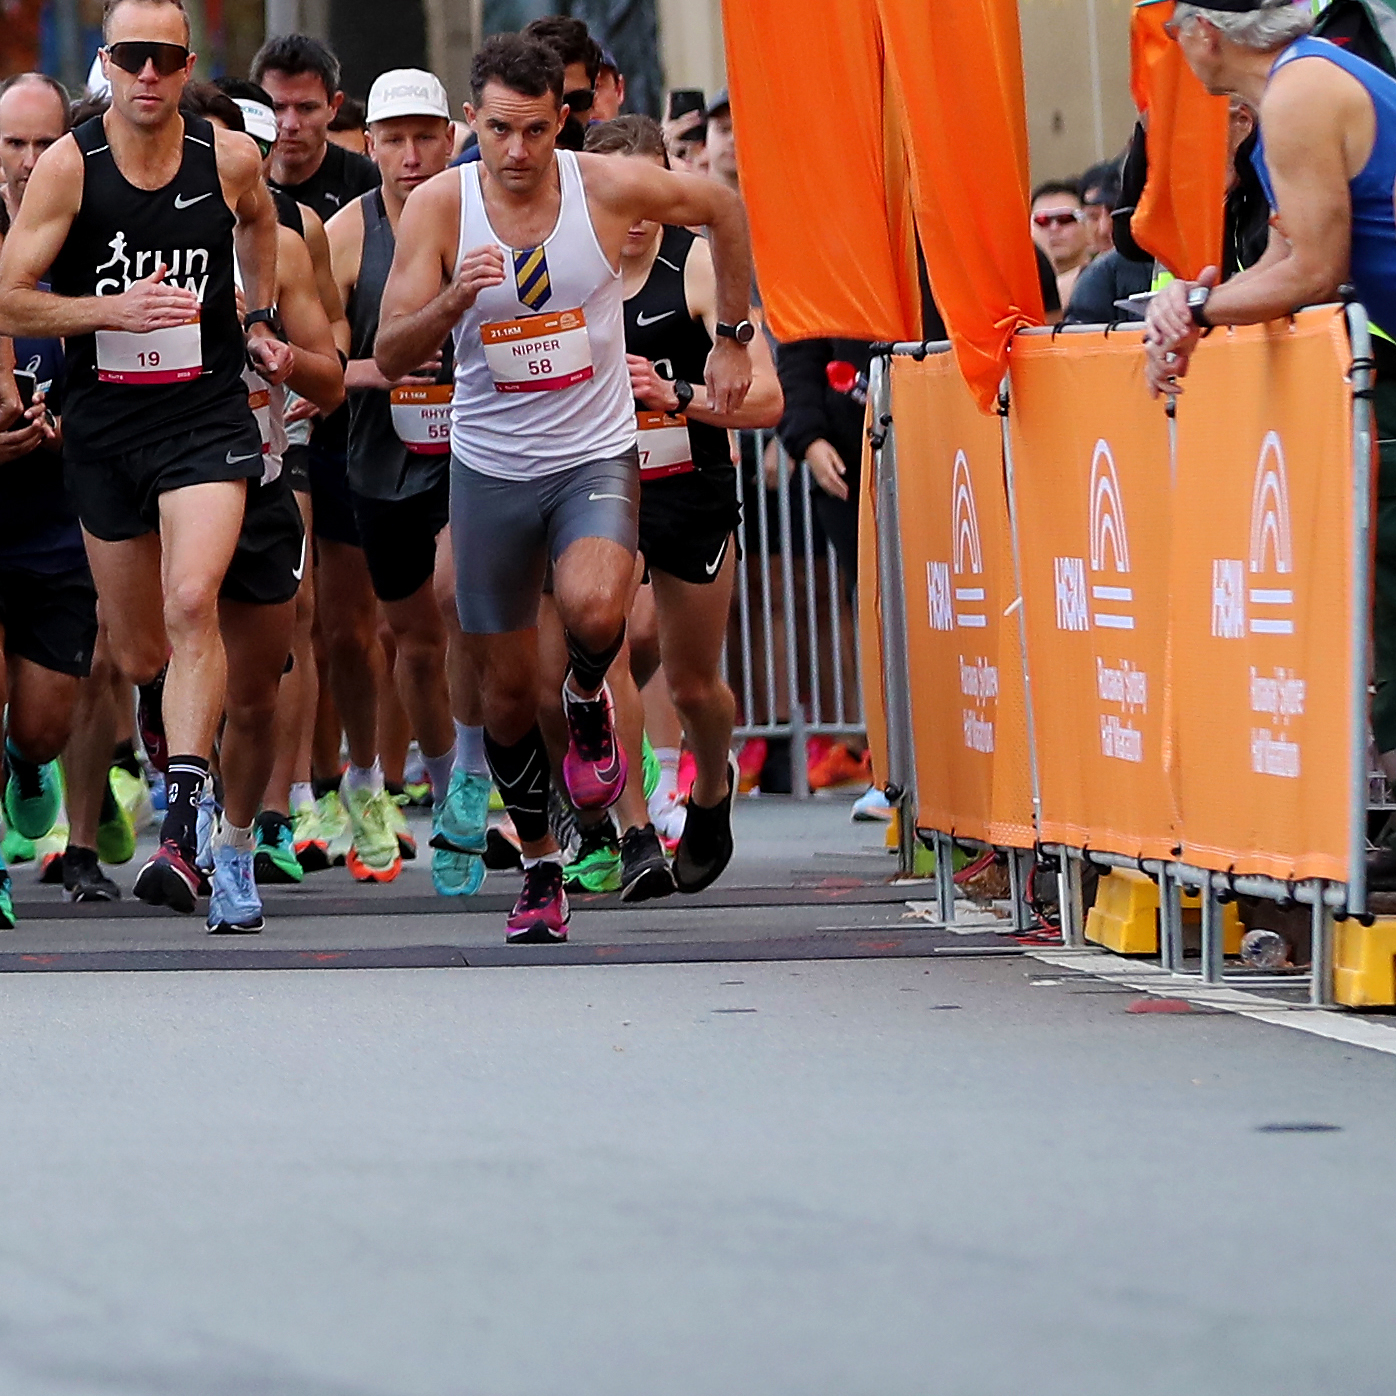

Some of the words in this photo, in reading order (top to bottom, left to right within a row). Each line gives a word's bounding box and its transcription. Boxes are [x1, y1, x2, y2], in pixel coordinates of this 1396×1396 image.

[136, 249, 208, 277] run
[491, 327, 522, 338] 21.1KM
[512, 339, 561, 357] NIPPER
[137, 352, 161, 367] 19
[528, 359, 552, 375] 58
[428, 425, 449, 438] 55
